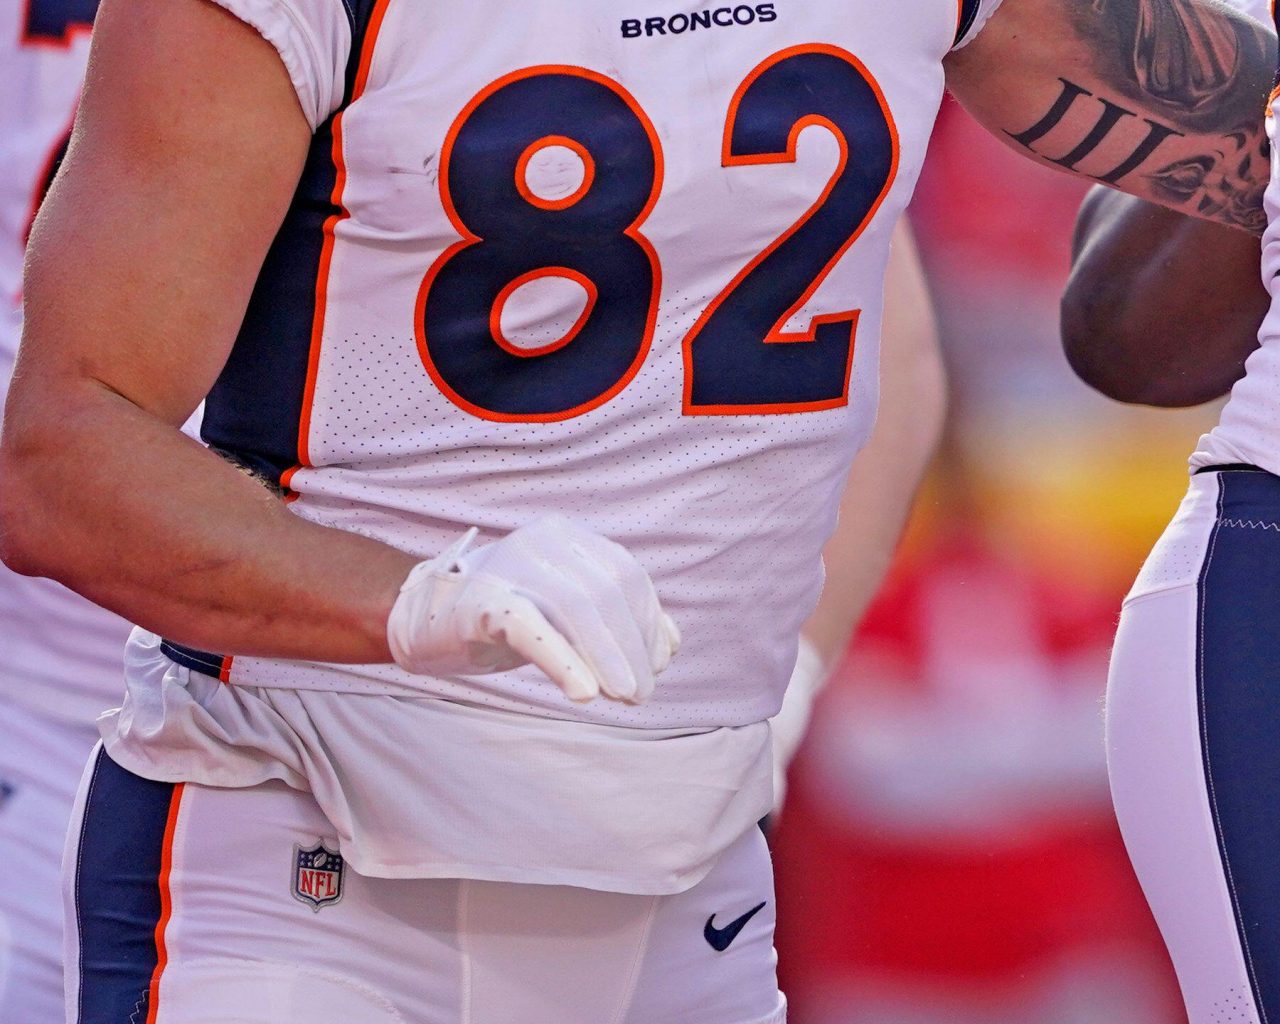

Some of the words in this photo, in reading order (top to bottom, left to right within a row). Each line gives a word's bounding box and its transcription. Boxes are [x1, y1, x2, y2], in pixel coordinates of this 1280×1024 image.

[620, 3, 778, 39] BRONCOS
[413, 42, 901, 424] 82
[299, 869, 337, 899] NFL
